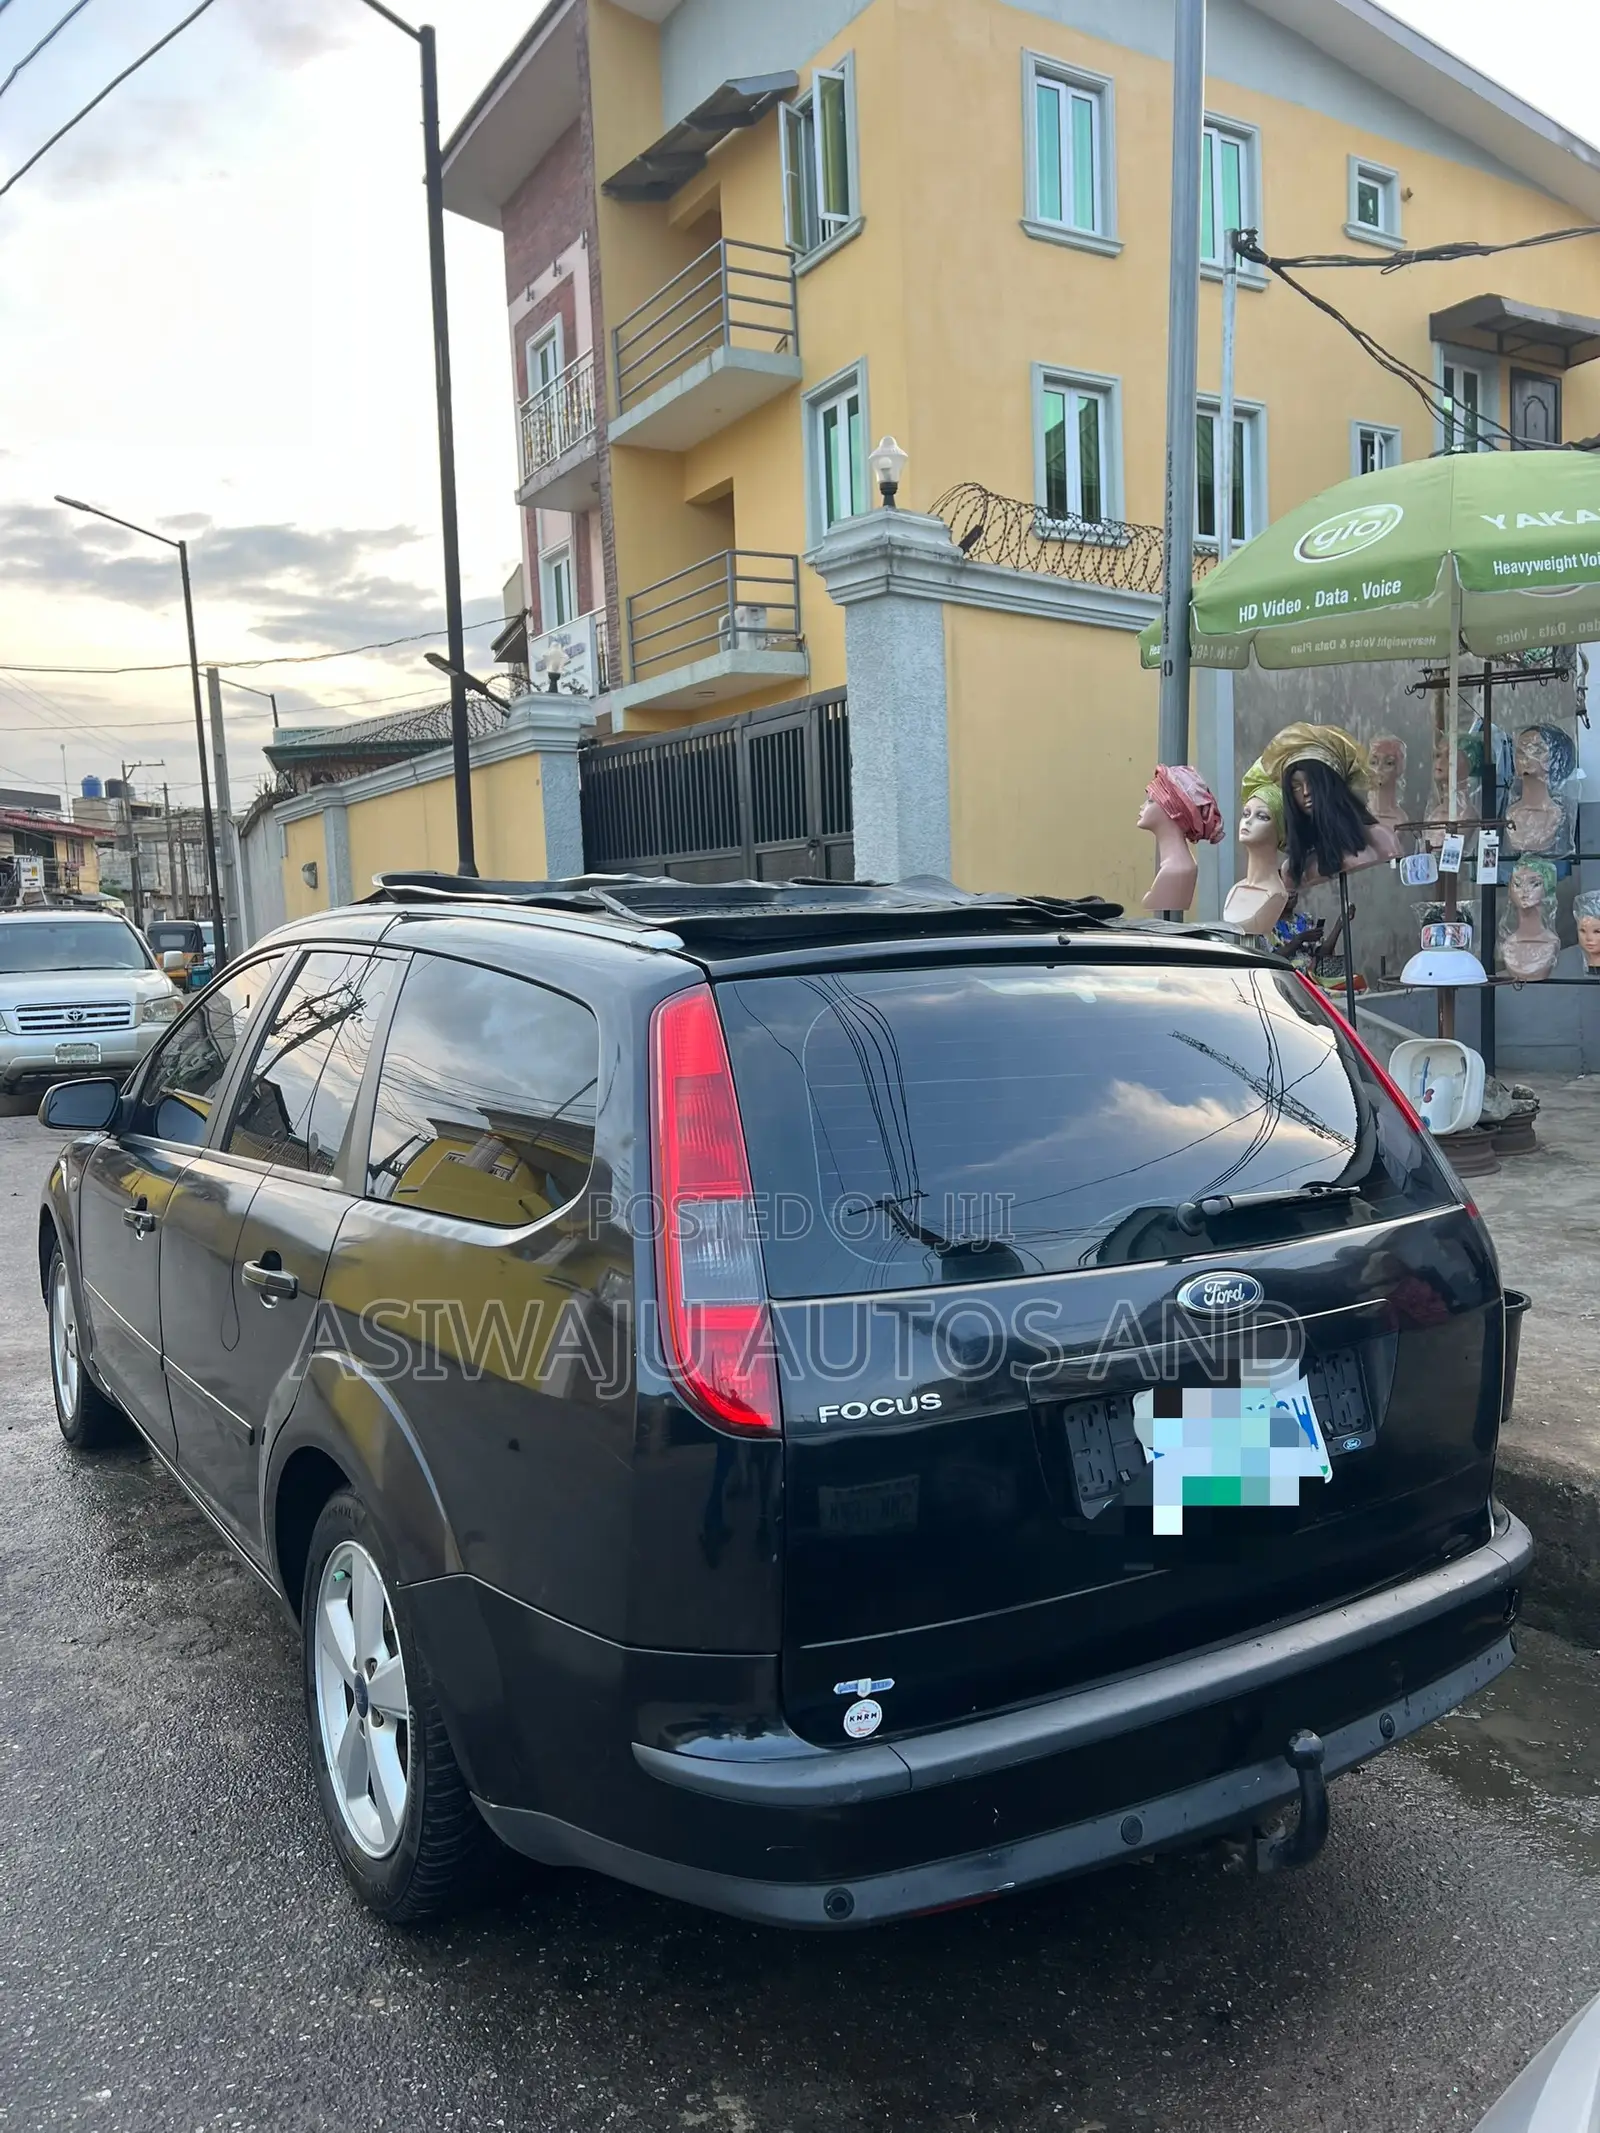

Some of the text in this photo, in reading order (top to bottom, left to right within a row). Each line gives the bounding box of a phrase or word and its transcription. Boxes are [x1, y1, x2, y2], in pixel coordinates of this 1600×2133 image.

[1480, 508, 1600, 530] YAKA
[1313, 519, 1382, 551] glo
[1493, 554, 1577, 576] Heavyweight
[1239, 604, 1258, 624] HD
[1262, 598, 1302, 618] Video
[1315, 588, 1349, 608] Data
[1361, 579, 1402, 600] Voice
[1204, 1280, 1245, 1306] Ford
[818, 1393, 942, 1424] FOCUS
